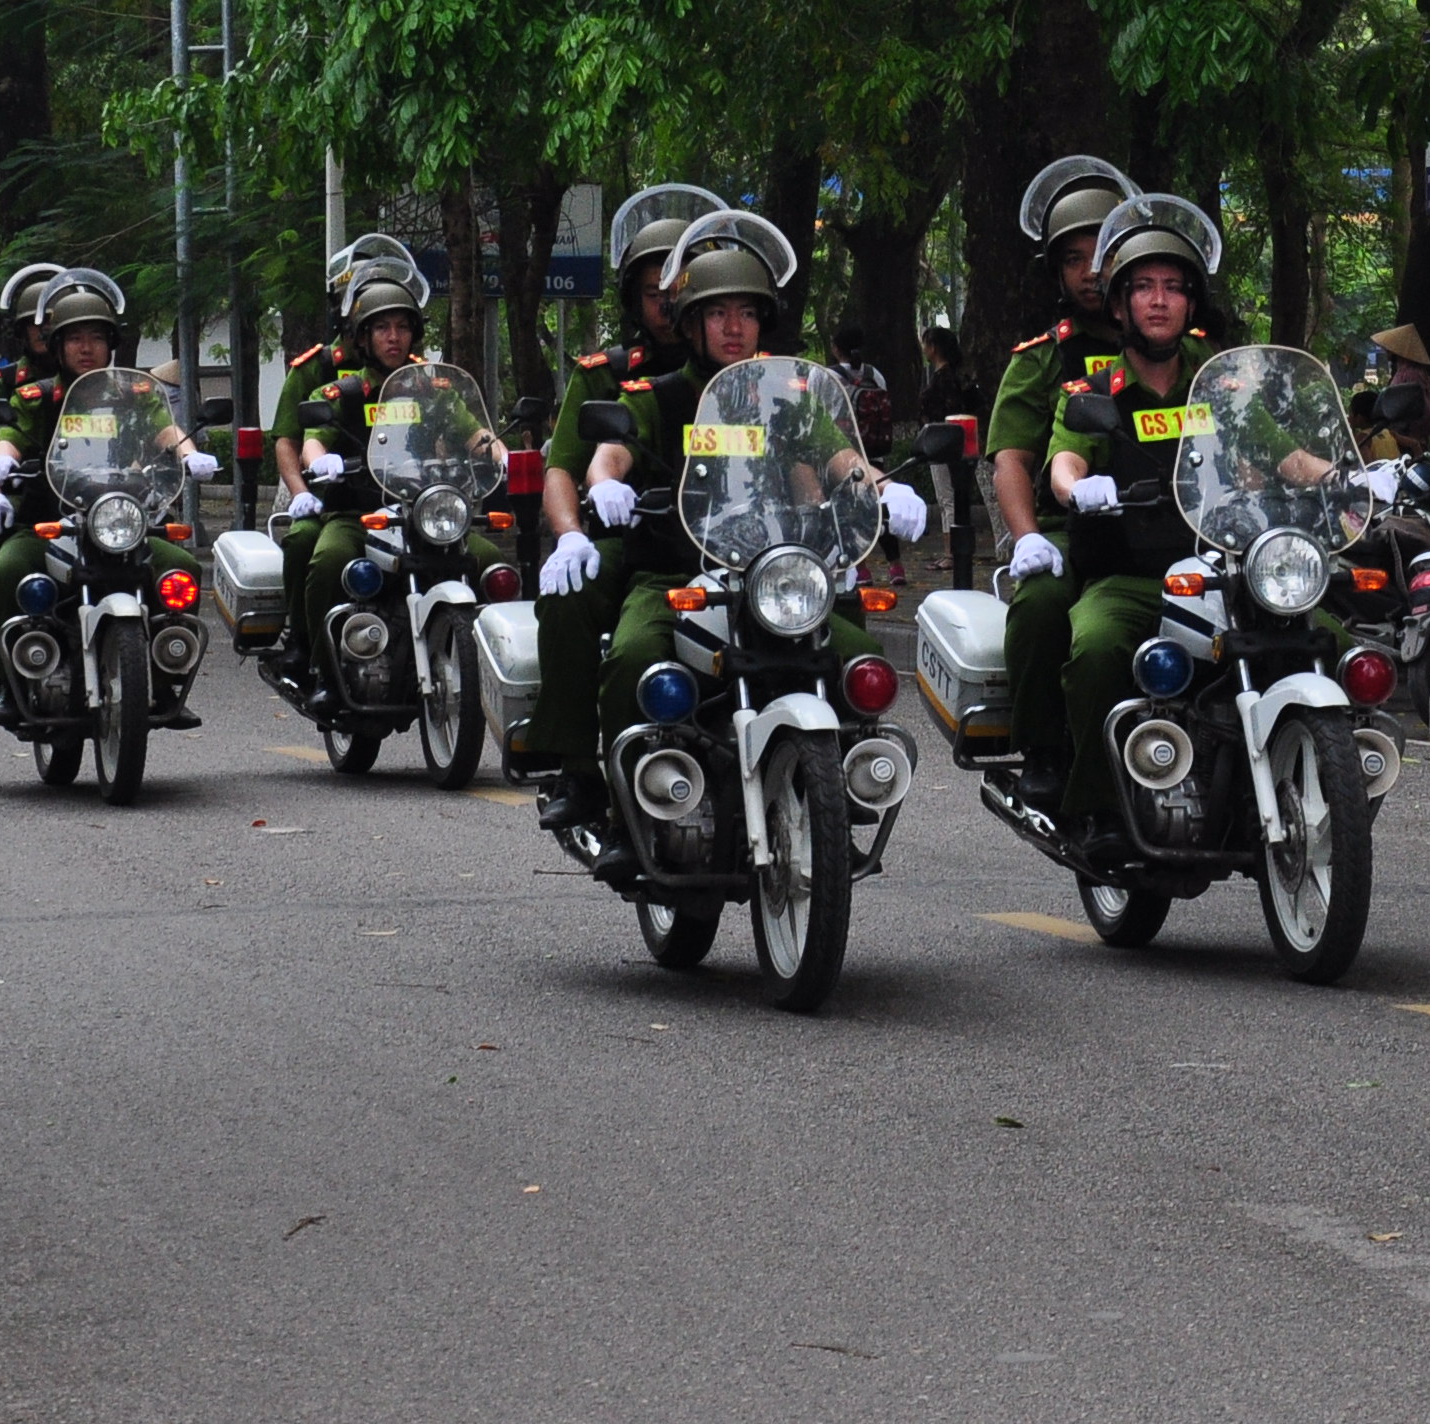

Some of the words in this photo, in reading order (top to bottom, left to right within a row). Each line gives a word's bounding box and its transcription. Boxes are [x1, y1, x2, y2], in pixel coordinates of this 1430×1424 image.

[1141, 412, 1168, 436] CS
[689, 428, 717, 452] CS
[921, 640, 952, 700] CSTT
